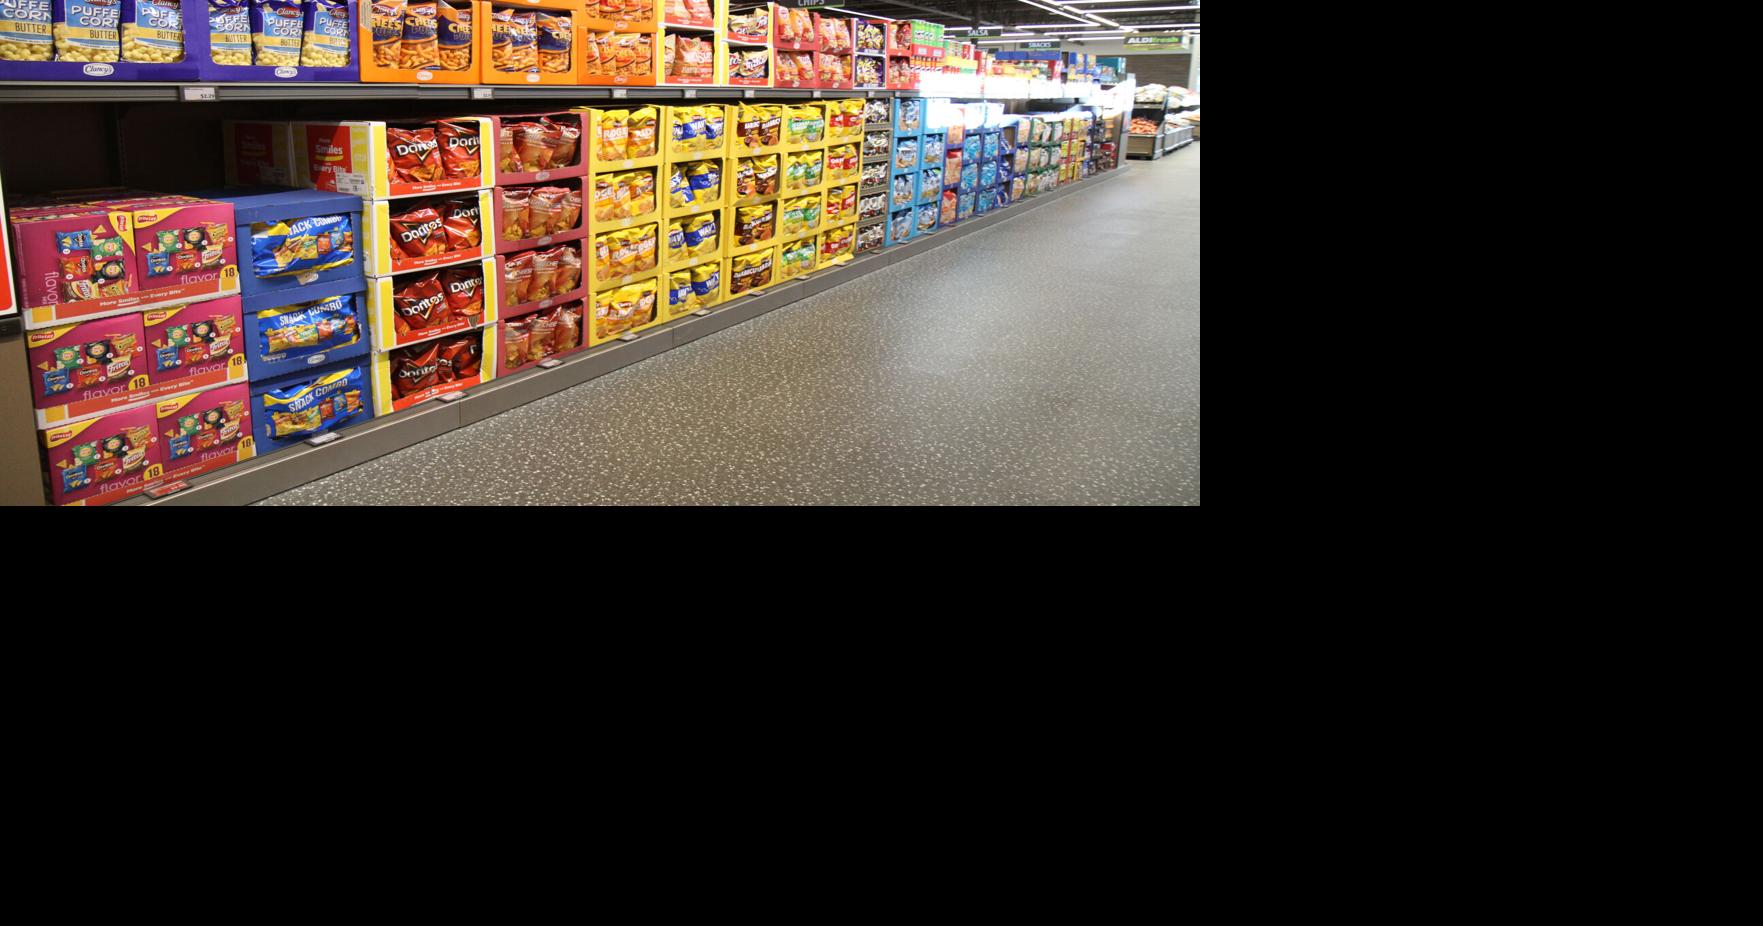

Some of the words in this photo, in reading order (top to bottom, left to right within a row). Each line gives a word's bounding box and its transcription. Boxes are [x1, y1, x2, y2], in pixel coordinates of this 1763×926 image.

[15, 22, 48, 34] BUTTER
[967, 29, 989, 37] SALSA
[89, 29, 117, 40] BUTTER
[156, 30, 183, 41] BUTTER
[225, 33, 248, 43] BUTTER
[84, 64, 115, 76] Clancy's
[315, 144, 343, 155] Smiles
[400, 218, 443, 243] Doritos
[181, 271, 219, 285] flavor
[224, 267, 235, 278] 18
[44, 271, 60, 304] flavor
[402, 292, 444, 316] Doritos
[279, 313, 307, 326] SNACK
[308, 300, 343, 316] COMBO
[108, 360, 129, 373] Fritos
[231, 356, 242, 366] 18
[189, 362, 226, 376] flavor
[134, 377, 146, 389] 18
[82, 384, 126, 400] flavor
[288, 395, 315, 412] SNACK
[315, 378, 348, 397] COMBO
[241, 438, 251, 448] 18
[201, 446, 235, 462] flavor
[148, 466, 160, 478] 18
[100, 475, 141, 494] flavor
